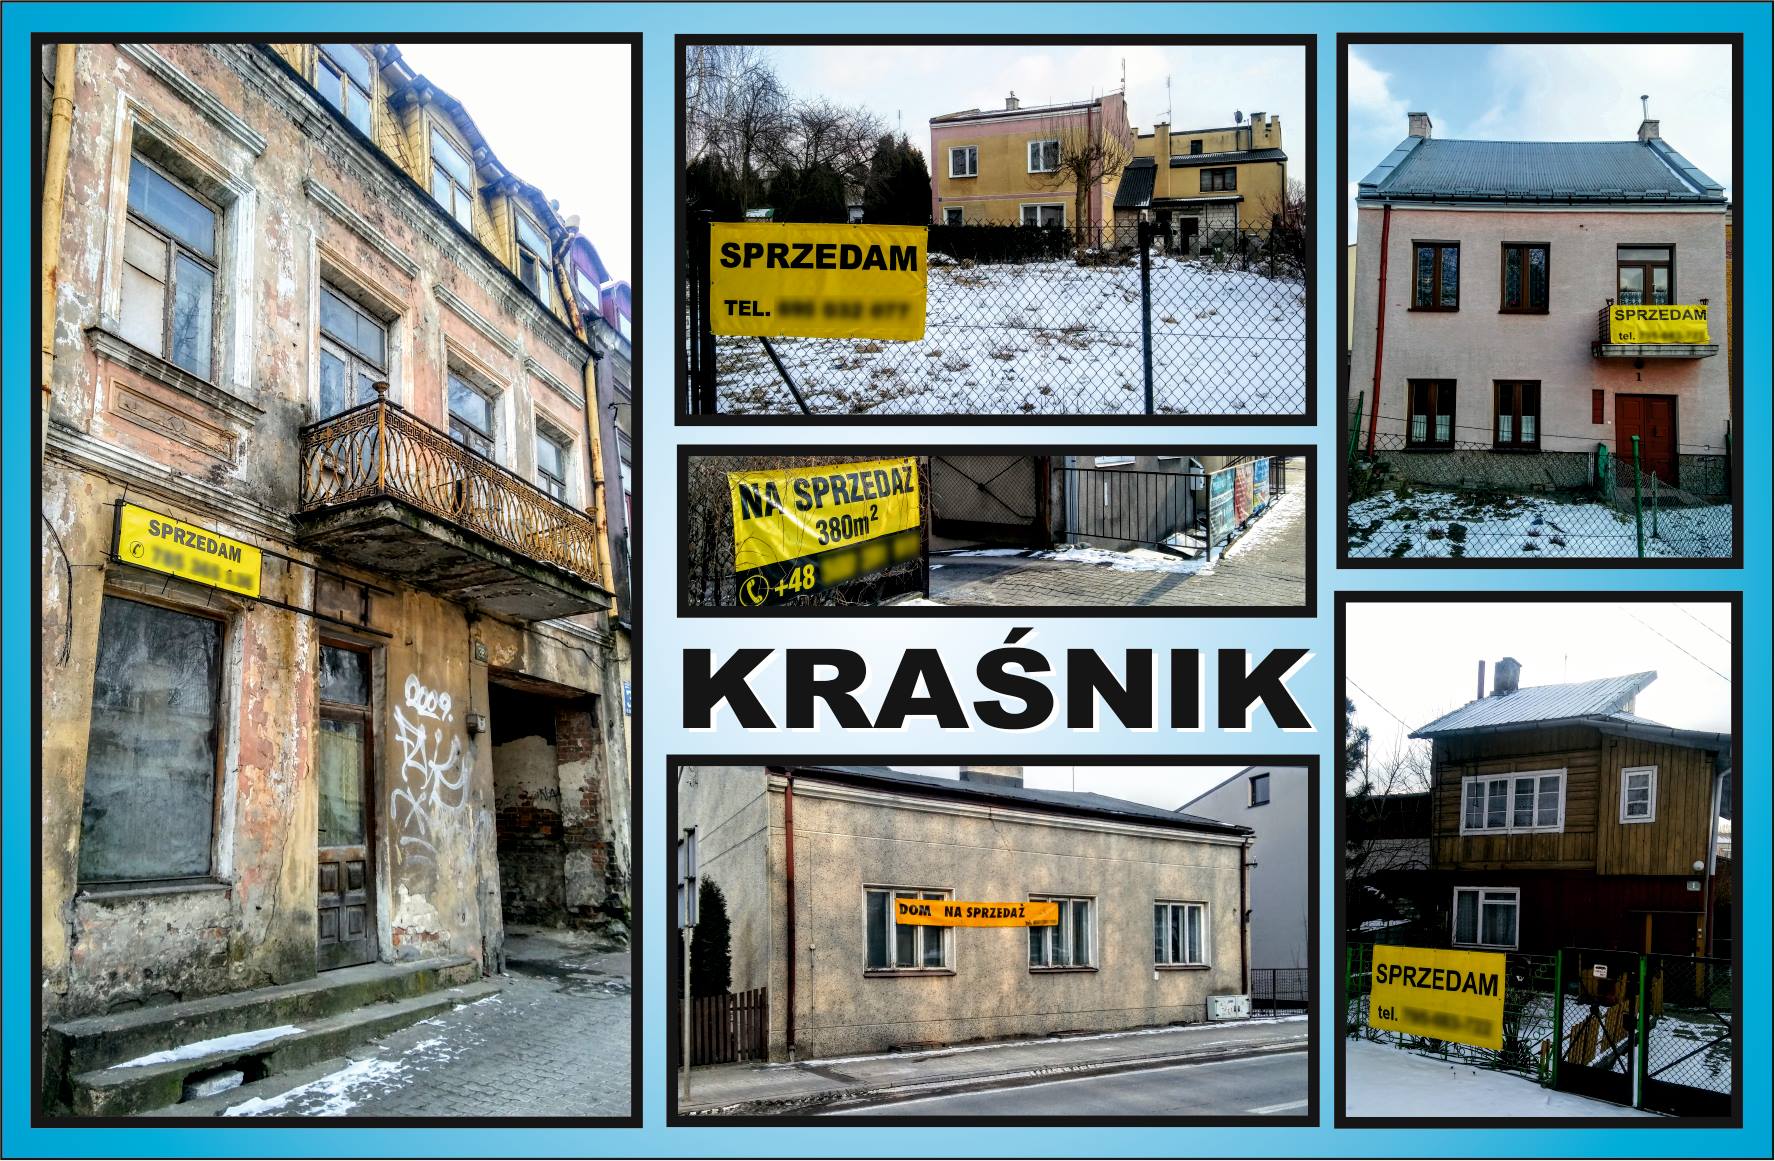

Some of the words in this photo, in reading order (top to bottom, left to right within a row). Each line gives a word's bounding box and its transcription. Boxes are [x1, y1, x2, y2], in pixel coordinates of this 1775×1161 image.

[720, 242, 917, 272] SPRZEDAM
[724, 300, 771, 316] TEL.
[1614, 309, 1707, 321] SPRZEDAM
[1618, 332, 1636, 340] tel.
[1636, 372, 1642, 382] 1
[738, 481, 785, 520] NA
[793, 459, 914, 512] SPRZEDAŻ
[148, 519, 242, 563] SPRZEDAM
[774, 564, 815, 597] +48
[898, 903, 932, 917] DOM
[944, 905, 962, 918] NA
[966, 903, 1025, 919] SPRZEDAŻ
[1376, 963, 1499, 997] SPRZEDAM
[1377, 1005, 1398, 1022] tel.
